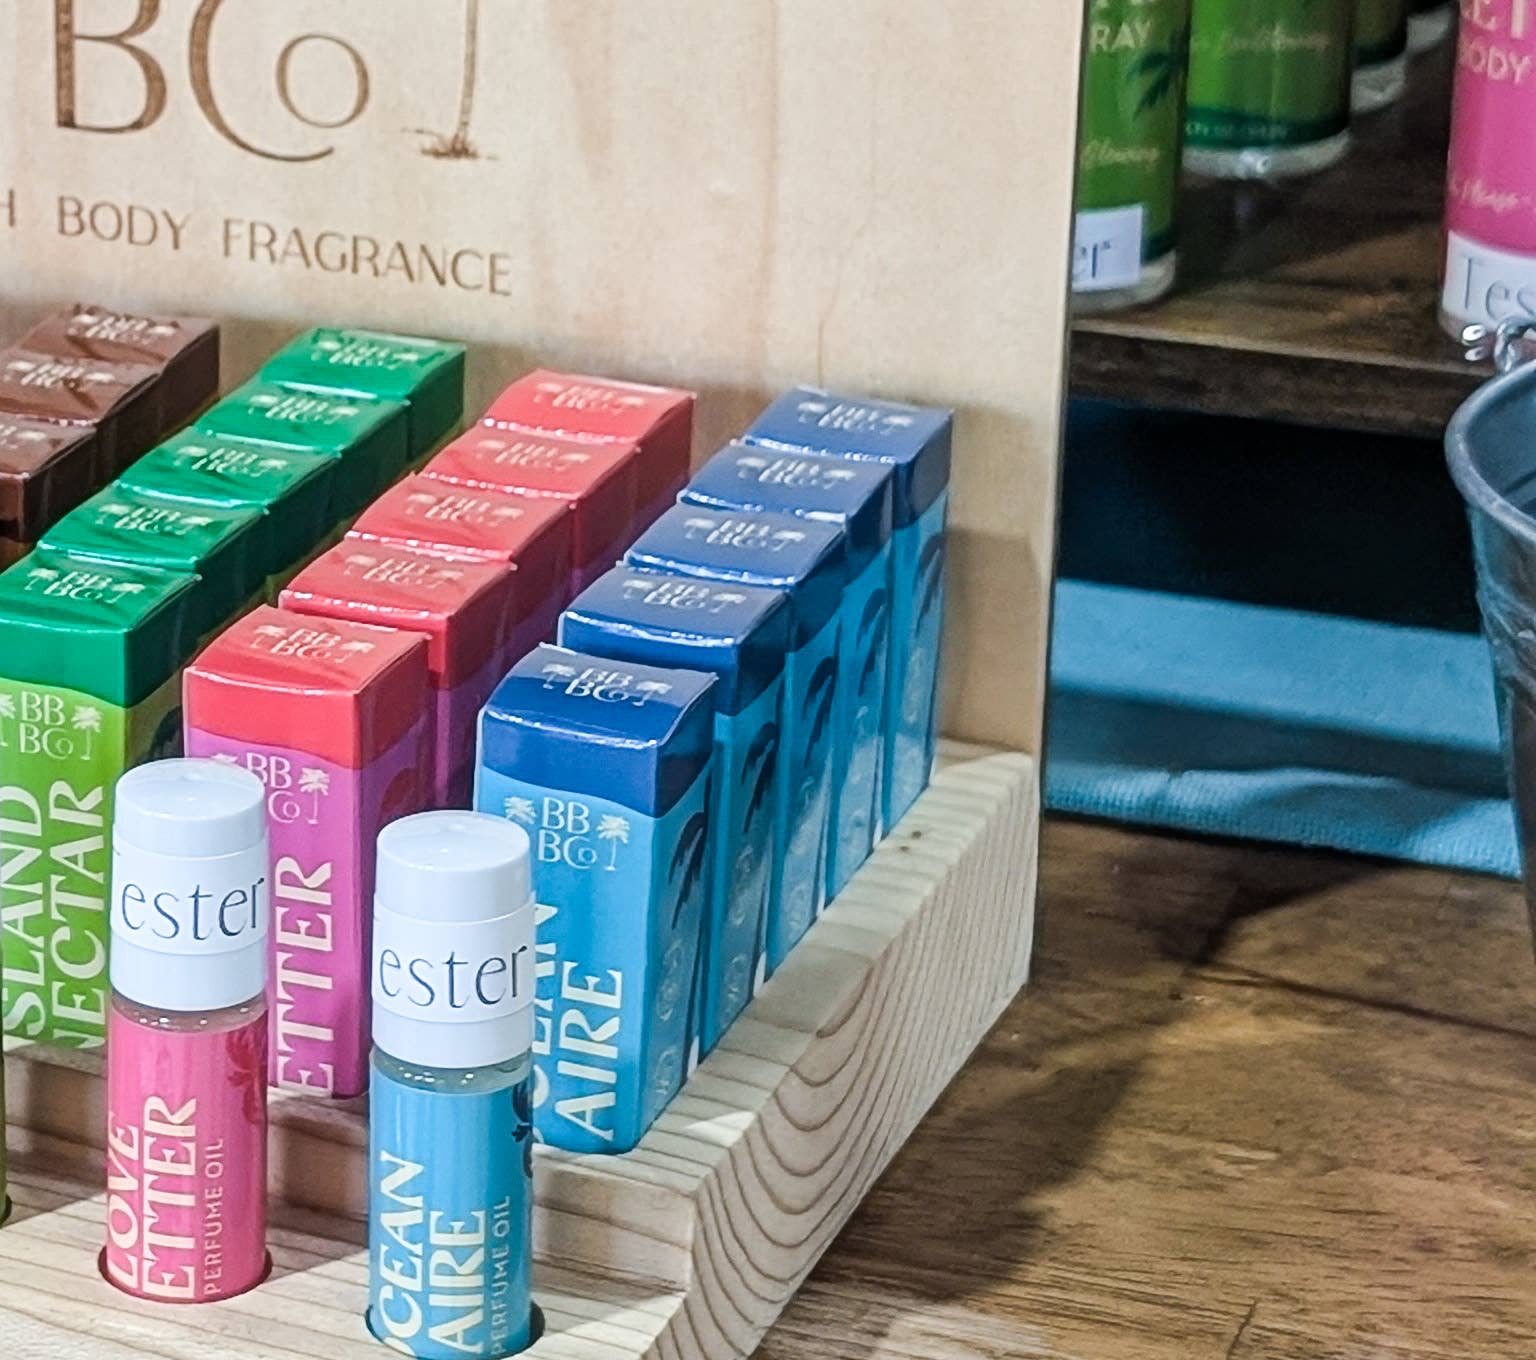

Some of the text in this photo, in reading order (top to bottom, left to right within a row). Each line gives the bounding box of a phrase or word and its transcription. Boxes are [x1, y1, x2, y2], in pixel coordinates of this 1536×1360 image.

[57, 195, 188, 251] BODY
[221, 217, 513, 298] FRAGRANCE
[20, 690, 67, 727] BB
[245, 751, 293, 790] BB
[541, 796, 591, 835] BB
[121, 876, 266, 941] ester
[273, 855, 335, 1099] ETTER
[378, 944, 528, 1010] ester
[554, 959, 624, 1143] AIRE
[107, 1112, 141, 1291] LOVE
[143, 1095, 199, 1300] ETTER
[203, 1138, 225, 1297] PERFUME OIL
[378, 1148, 425, 1357] CEAN
[428, 1209, 488, 1355] AIRE
[489, 1195, 511, 1358] PERFUME OIL
